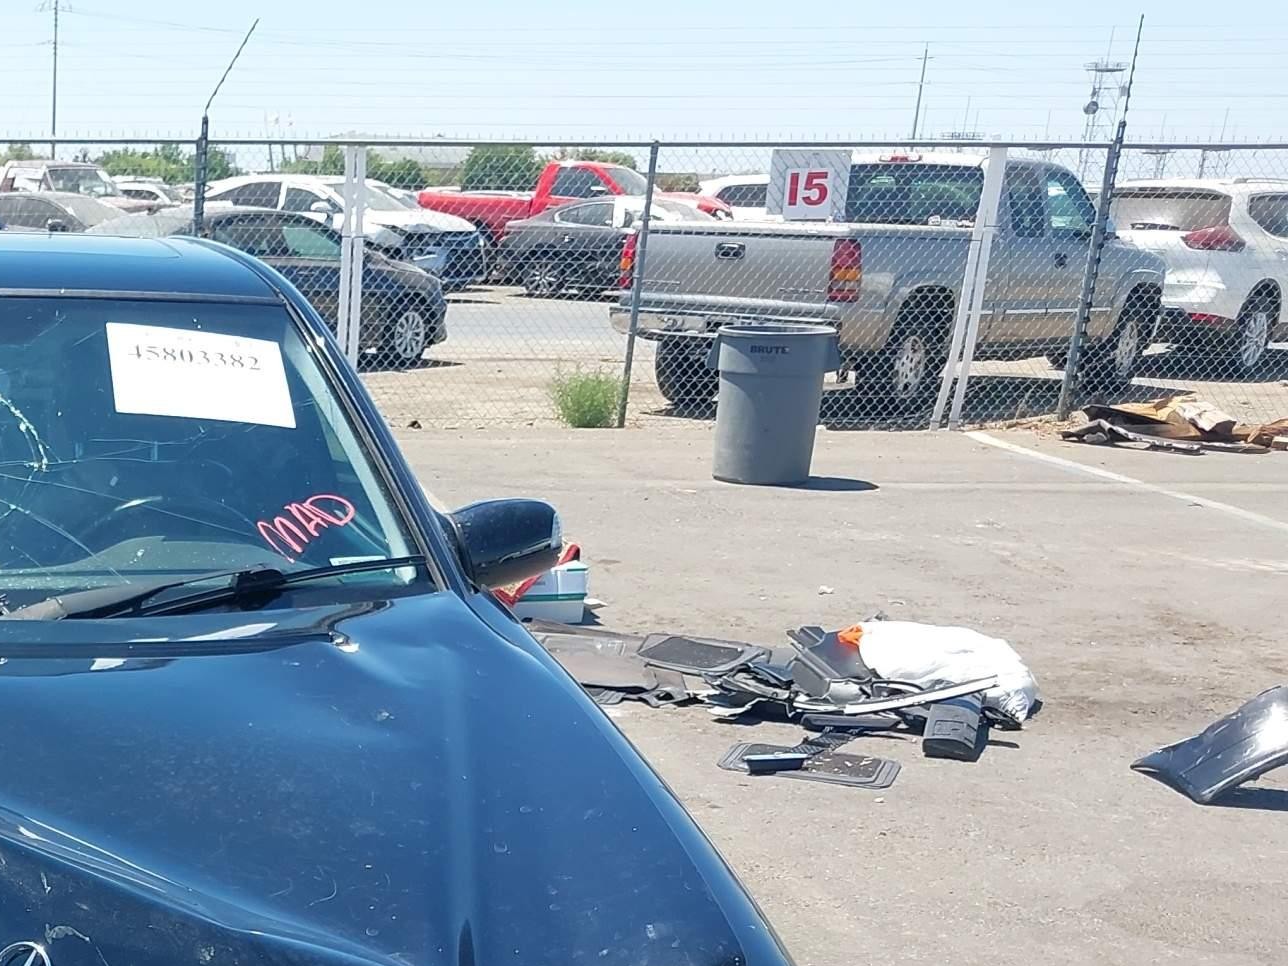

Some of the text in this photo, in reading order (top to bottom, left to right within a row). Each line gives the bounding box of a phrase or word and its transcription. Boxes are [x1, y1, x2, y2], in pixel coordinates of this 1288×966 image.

[788, 172, 828, 206] 15
[128, 344, 261, 371] 45803382
[750, 345, 790, 354] BRUTE
